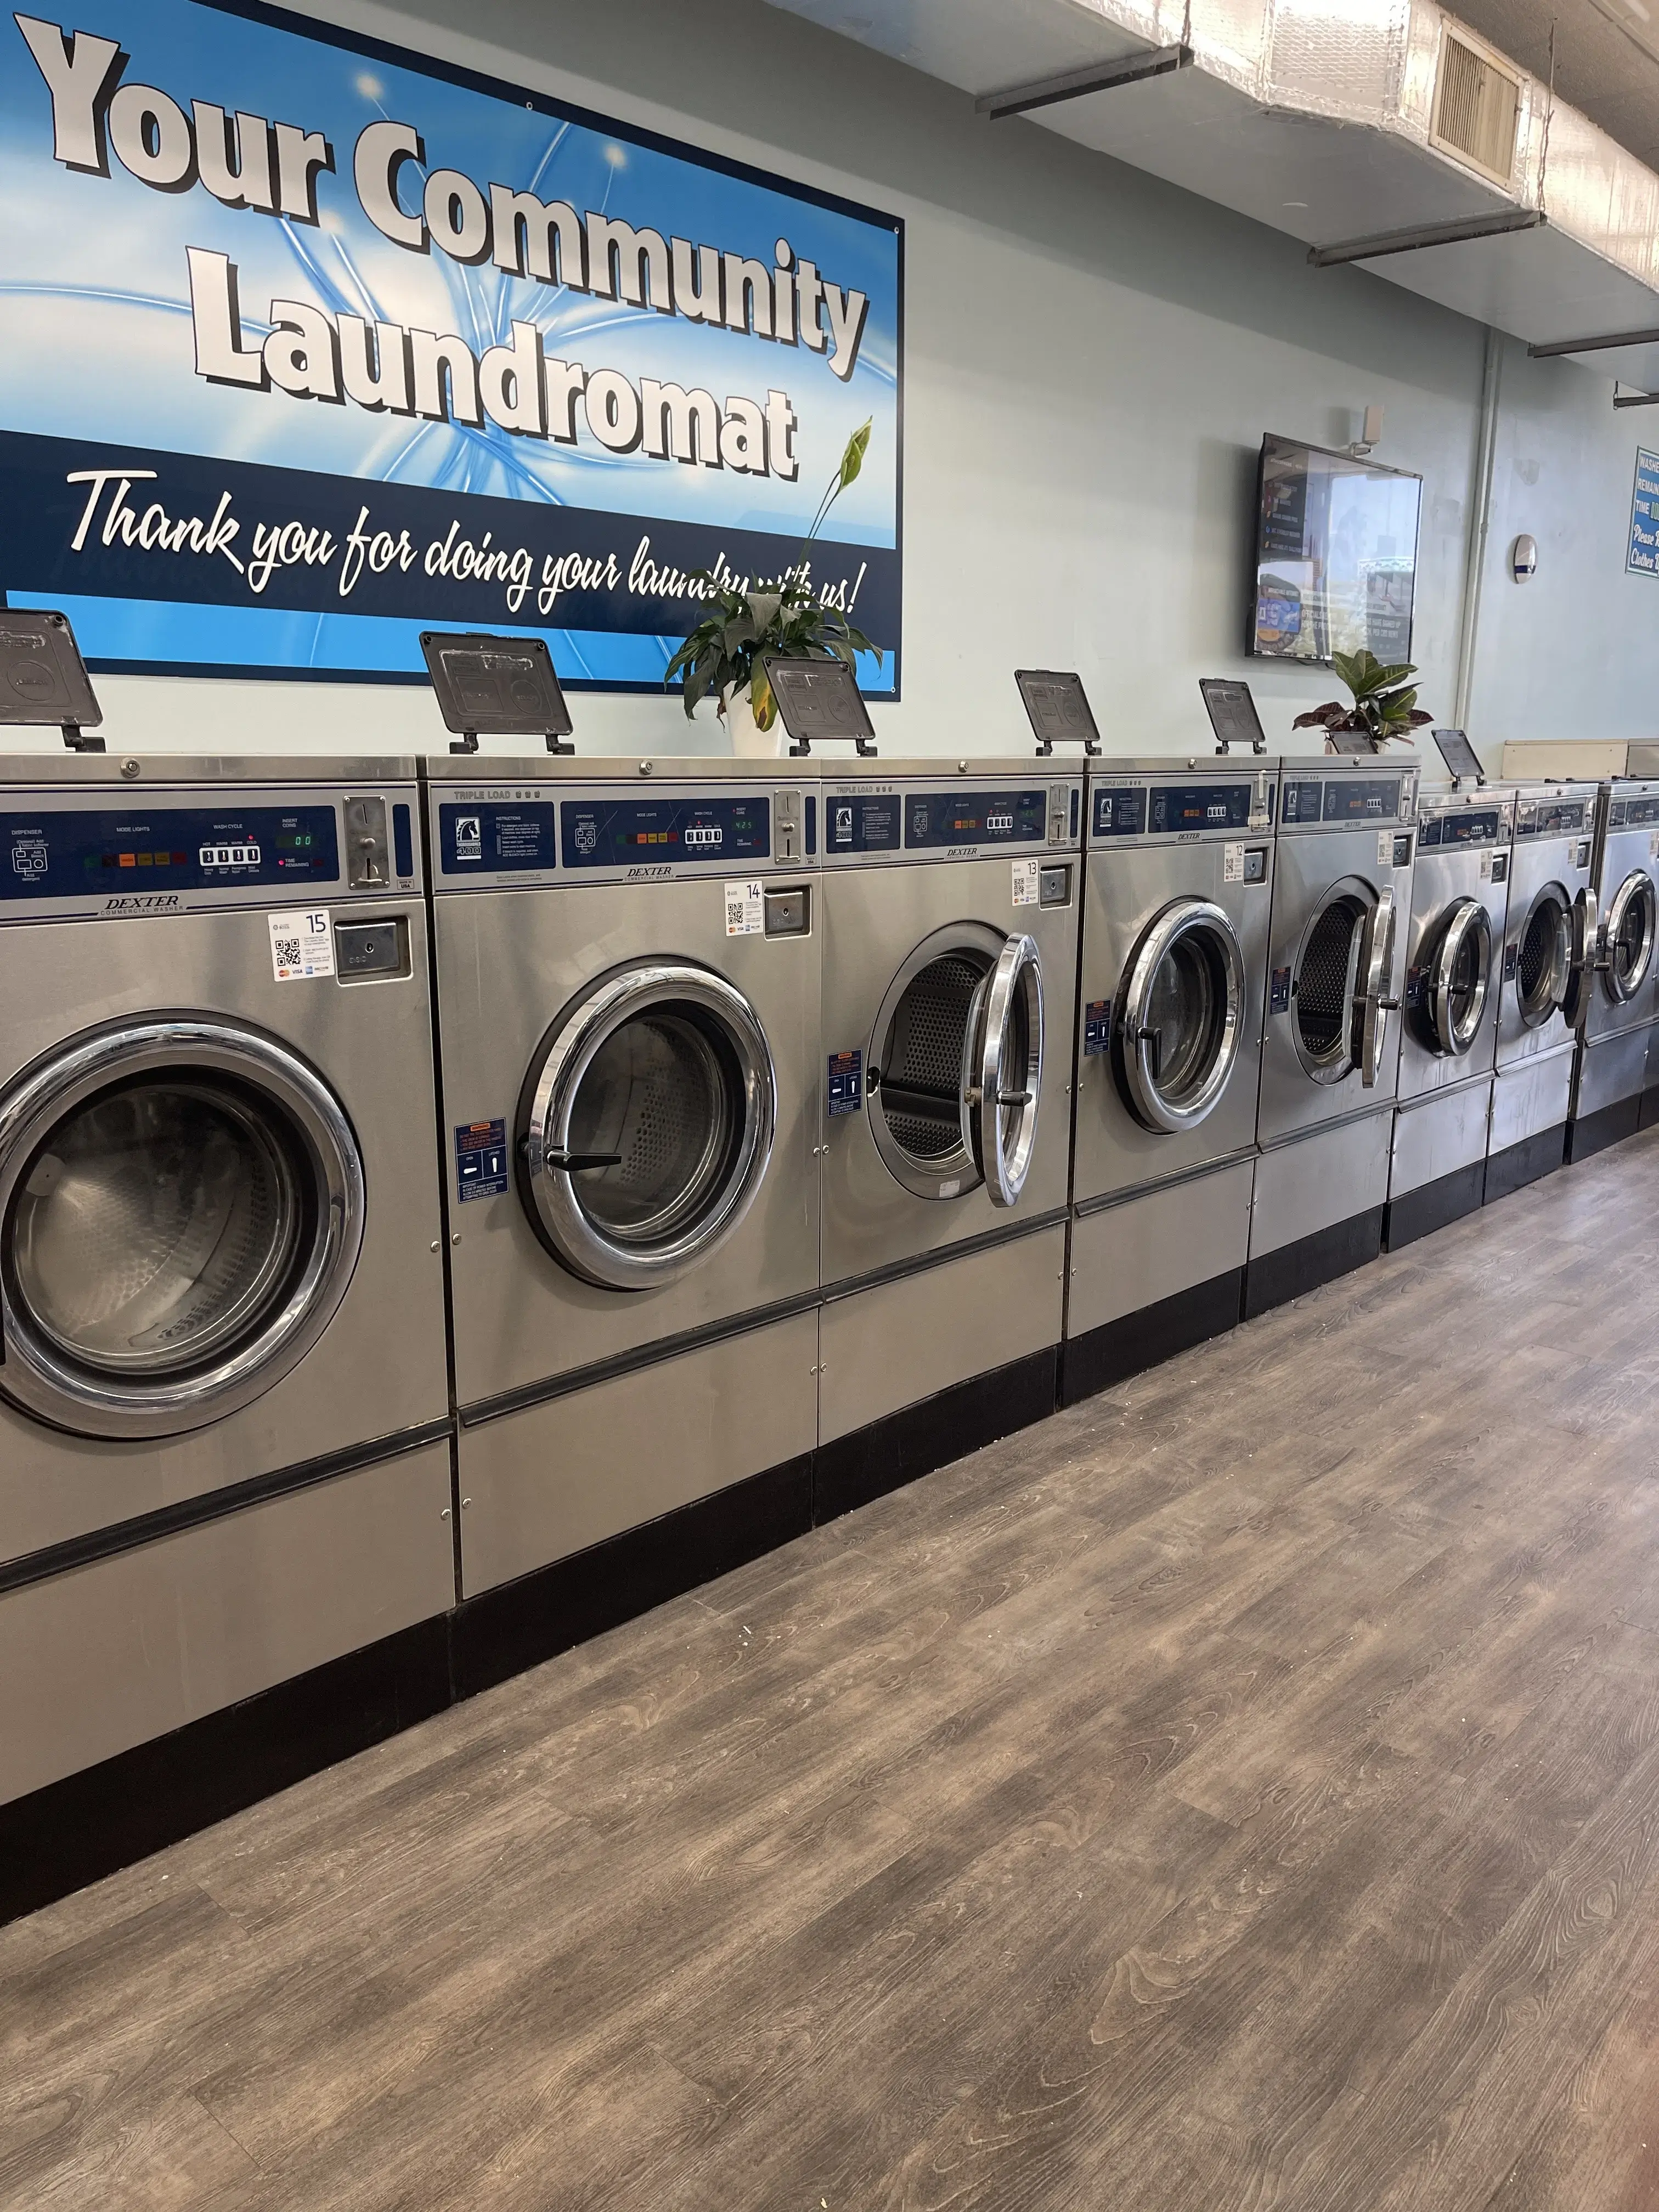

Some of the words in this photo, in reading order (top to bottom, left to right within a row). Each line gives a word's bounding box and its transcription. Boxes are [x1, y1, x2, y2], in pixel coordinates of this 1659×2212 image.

[13, 12, 336, 227] Your
[354, 120, 870, 382] Community
[185, 246, 798, 482] Laundromat
[1635, 499, 1650, 515] TIME
[1634, 524, 1654, 545] Please
[67, 470, 244, 574] Thank
[248, 521, 338, 593] you
[338, 506, 417, 596] for
[425, 520, 537, 613] doing
[538, 552, 622, 615] your
[819, 561, 867, 613] us!
[1631, 548, 1654, 569] Clothes
[454, 791, 484, 799] TRIPLE
[488, 791, 511, 799] LOAD
[456, 847, 482, 855] 400
[947, 848, 977, 856] DEXTER
[1236, 845, 1243, 855] 12
[627, 867, 672, 877] DEXTER
[1028, 862, 1036, 874] 13
[747, 884, 760, 899] 14
[104, 896, 178, 910] DEXTER
[306, 914, 326, 933] 15
